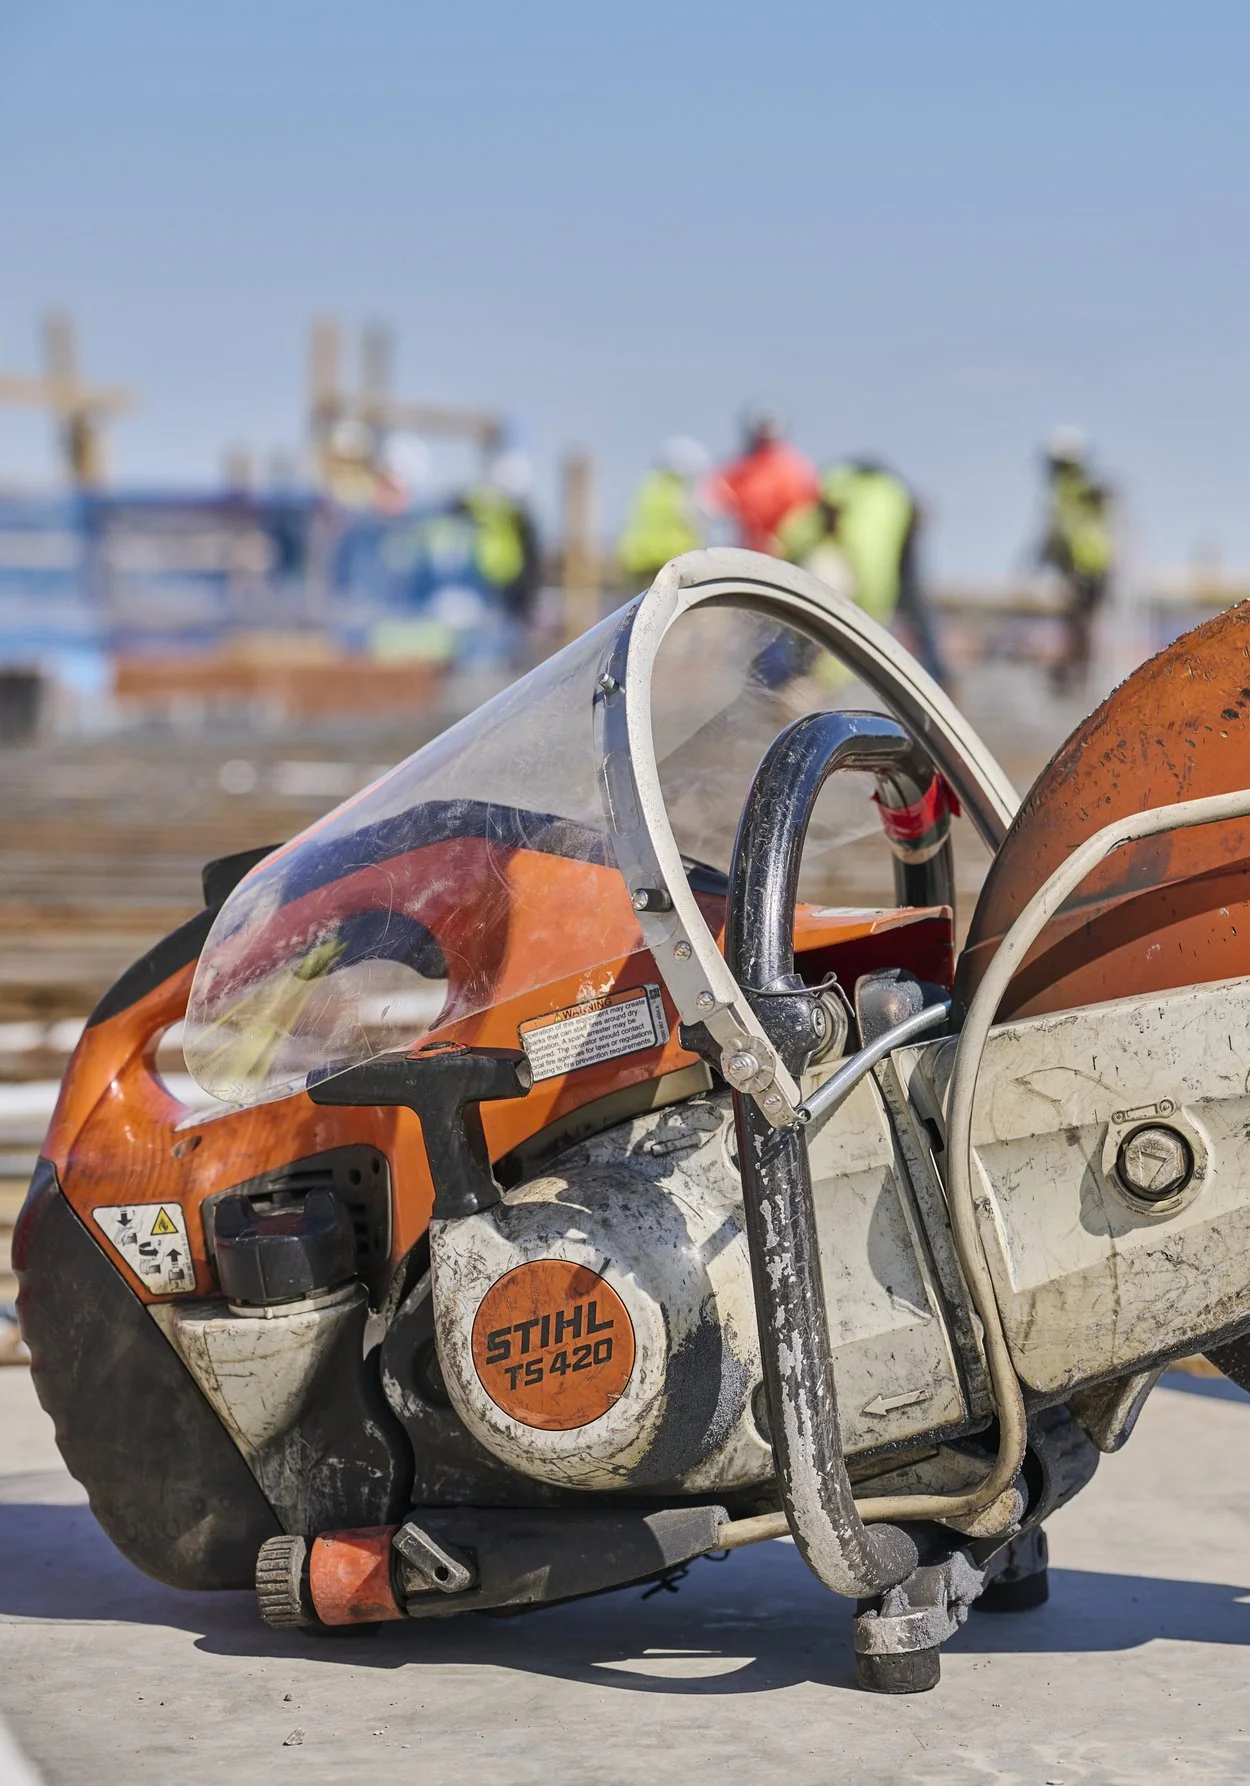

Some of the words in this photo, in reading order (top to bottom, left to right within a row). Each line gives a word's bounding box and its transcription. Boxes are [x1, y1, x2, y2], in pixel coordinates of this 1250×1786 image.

[546, 1032, 559, 1041] that
[560, 1028, 573, 1037] can
[603, 1011, 627, 1025] around
[627, 1008, 638, 1018] dry
[555, 1023, 562, 1031] of
[562, 1020, 575, 1029] this
[609, 1005, 624, 1015] may
[625, 1000, 645, 1009] create
[587, 1025, 611, 1038] arrester
[612, 1019, 626, 1030] may
[530, 1050, 555, 1063] equired.
[557, 1046, 570, 1054] The
[598, 1029, 620, 1043] should
[621, 1022, 645, 1035] contact
[532, 1060, 545, 1071] ocal
[545, 1058, 556, 1066] fire
[585, 1046, 595, 1055] for
[594, 1042, 610, 1051] laws
[610, 1039, 618, 1047] or
[618, 1029, 653, 1044] regulations
[534, 1067, 556, 1078] elating
[555, 1063, 563, 1071] to
[575, 1051, 609, 1067] prevention
[609, 1038, 653, 1056] requirements.
[485, 1300, 615, 1366] STIHL
[504, 1357, 544, 1391] TS
[549, 1337, 613, 1377] 420
